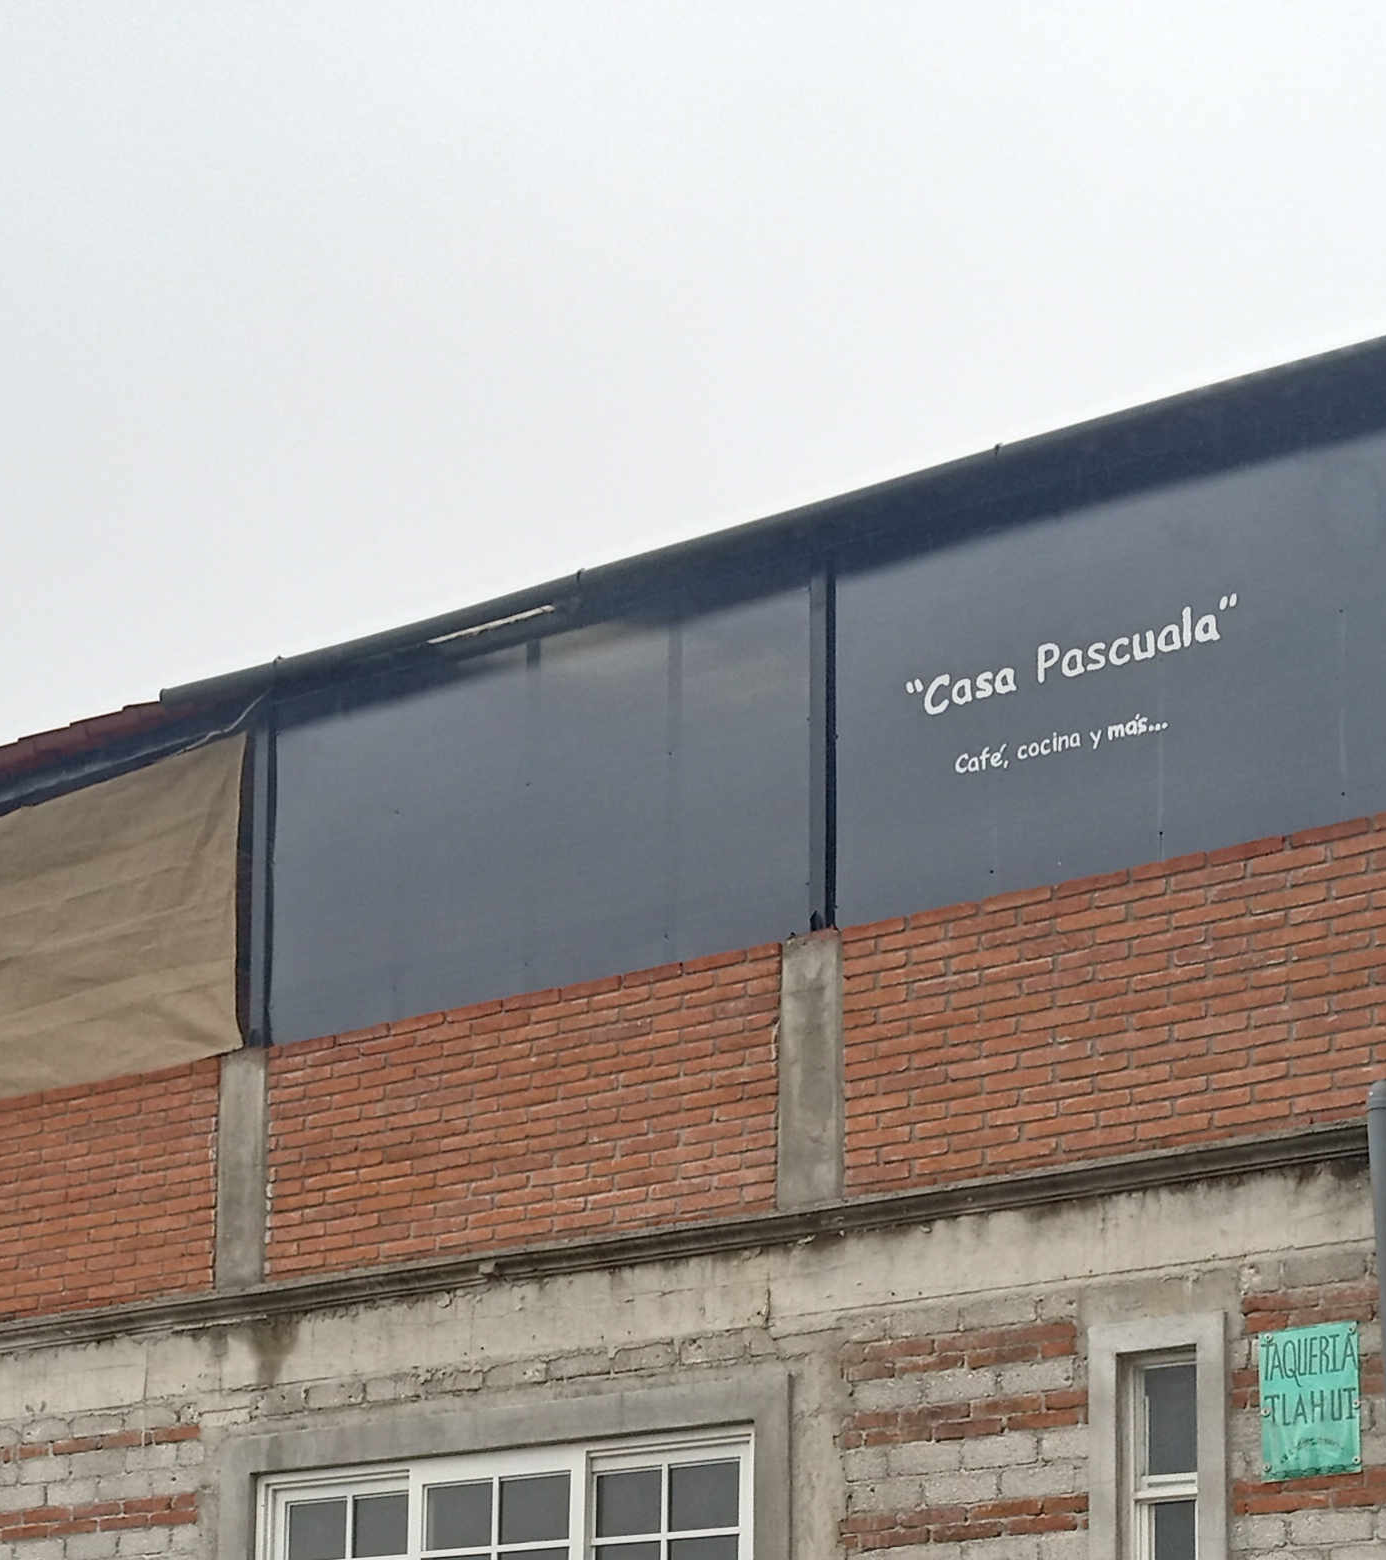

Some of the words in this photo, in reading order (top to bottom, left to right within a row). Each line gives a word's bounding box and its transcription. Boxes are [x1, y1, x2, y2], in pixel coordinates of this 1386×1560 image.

[954, 743, 1010, 774] Café,
[1017, 731, 1081, 761] cocina
[1089, 729, 1102, 750] y
[1107, 713, 1169, 741] más...
